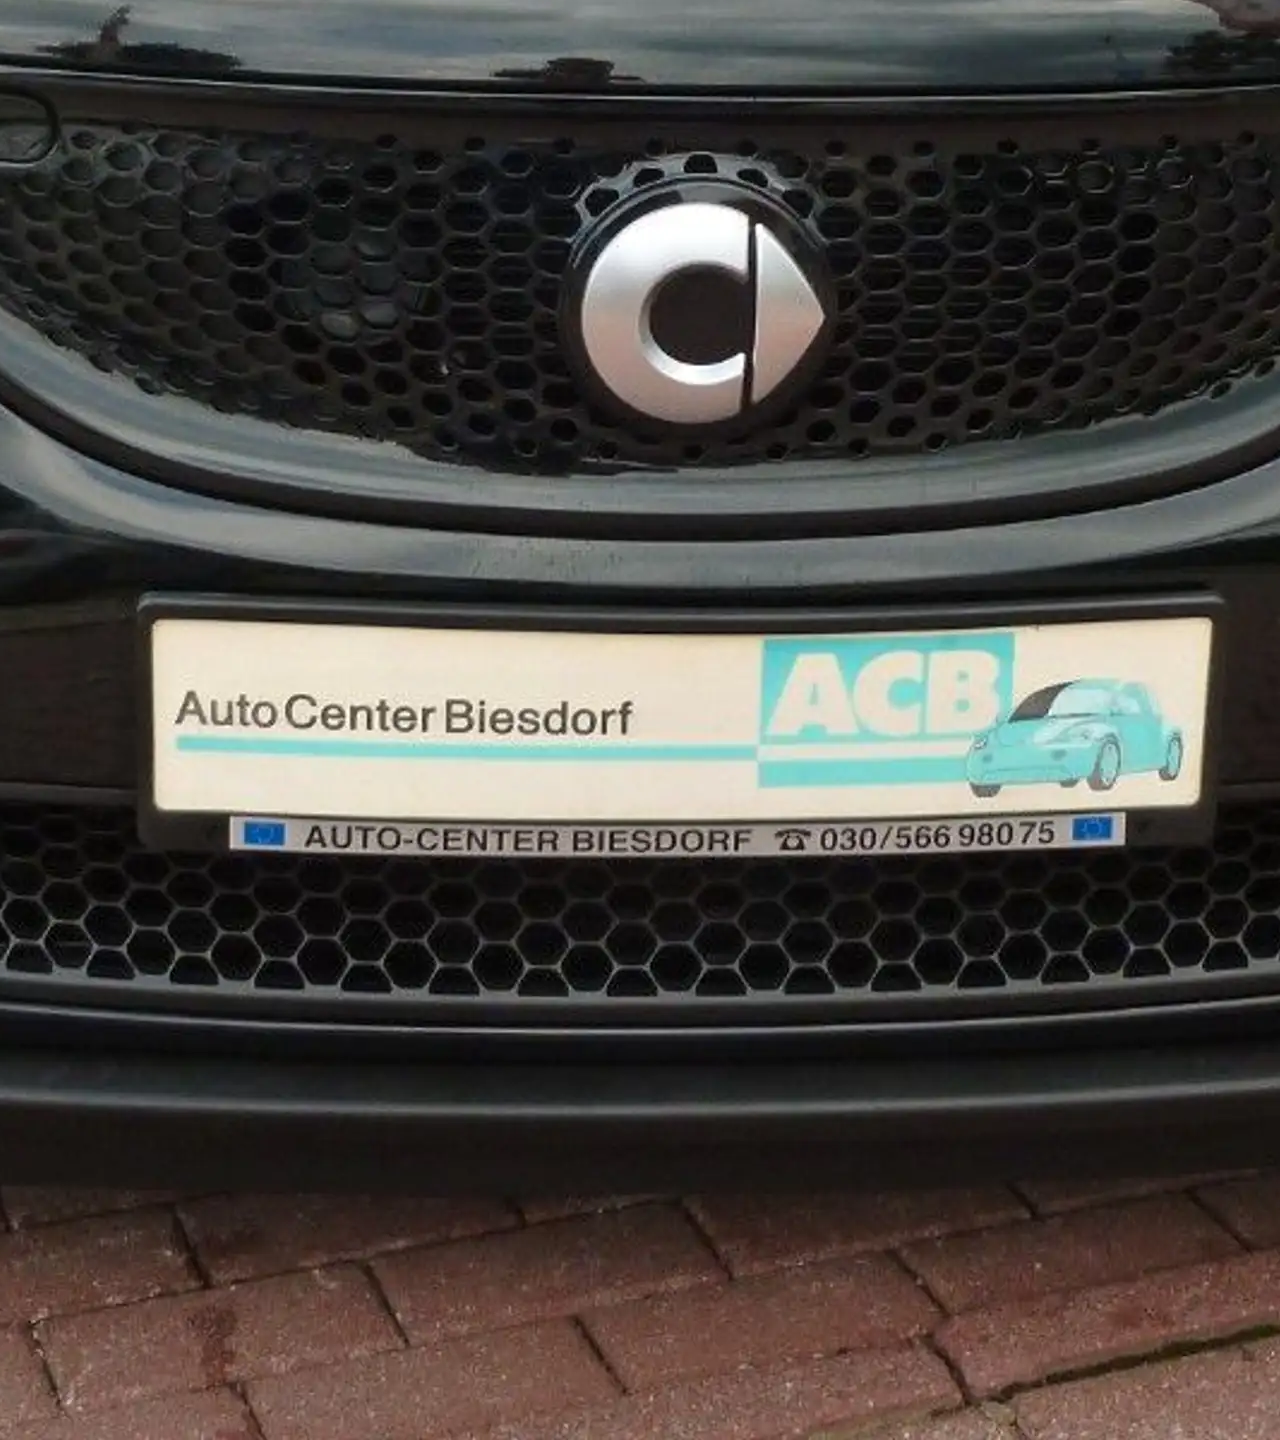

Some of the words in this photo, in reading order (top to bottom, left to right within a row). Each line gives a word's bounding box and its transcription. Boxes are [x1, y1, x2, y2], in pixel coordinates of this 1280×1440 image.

[765, 650, 1001, 736] ACB
[304, 825, 559, 852] AUTO-CENTER
[572, 828, 754, 852] BIESDORF
